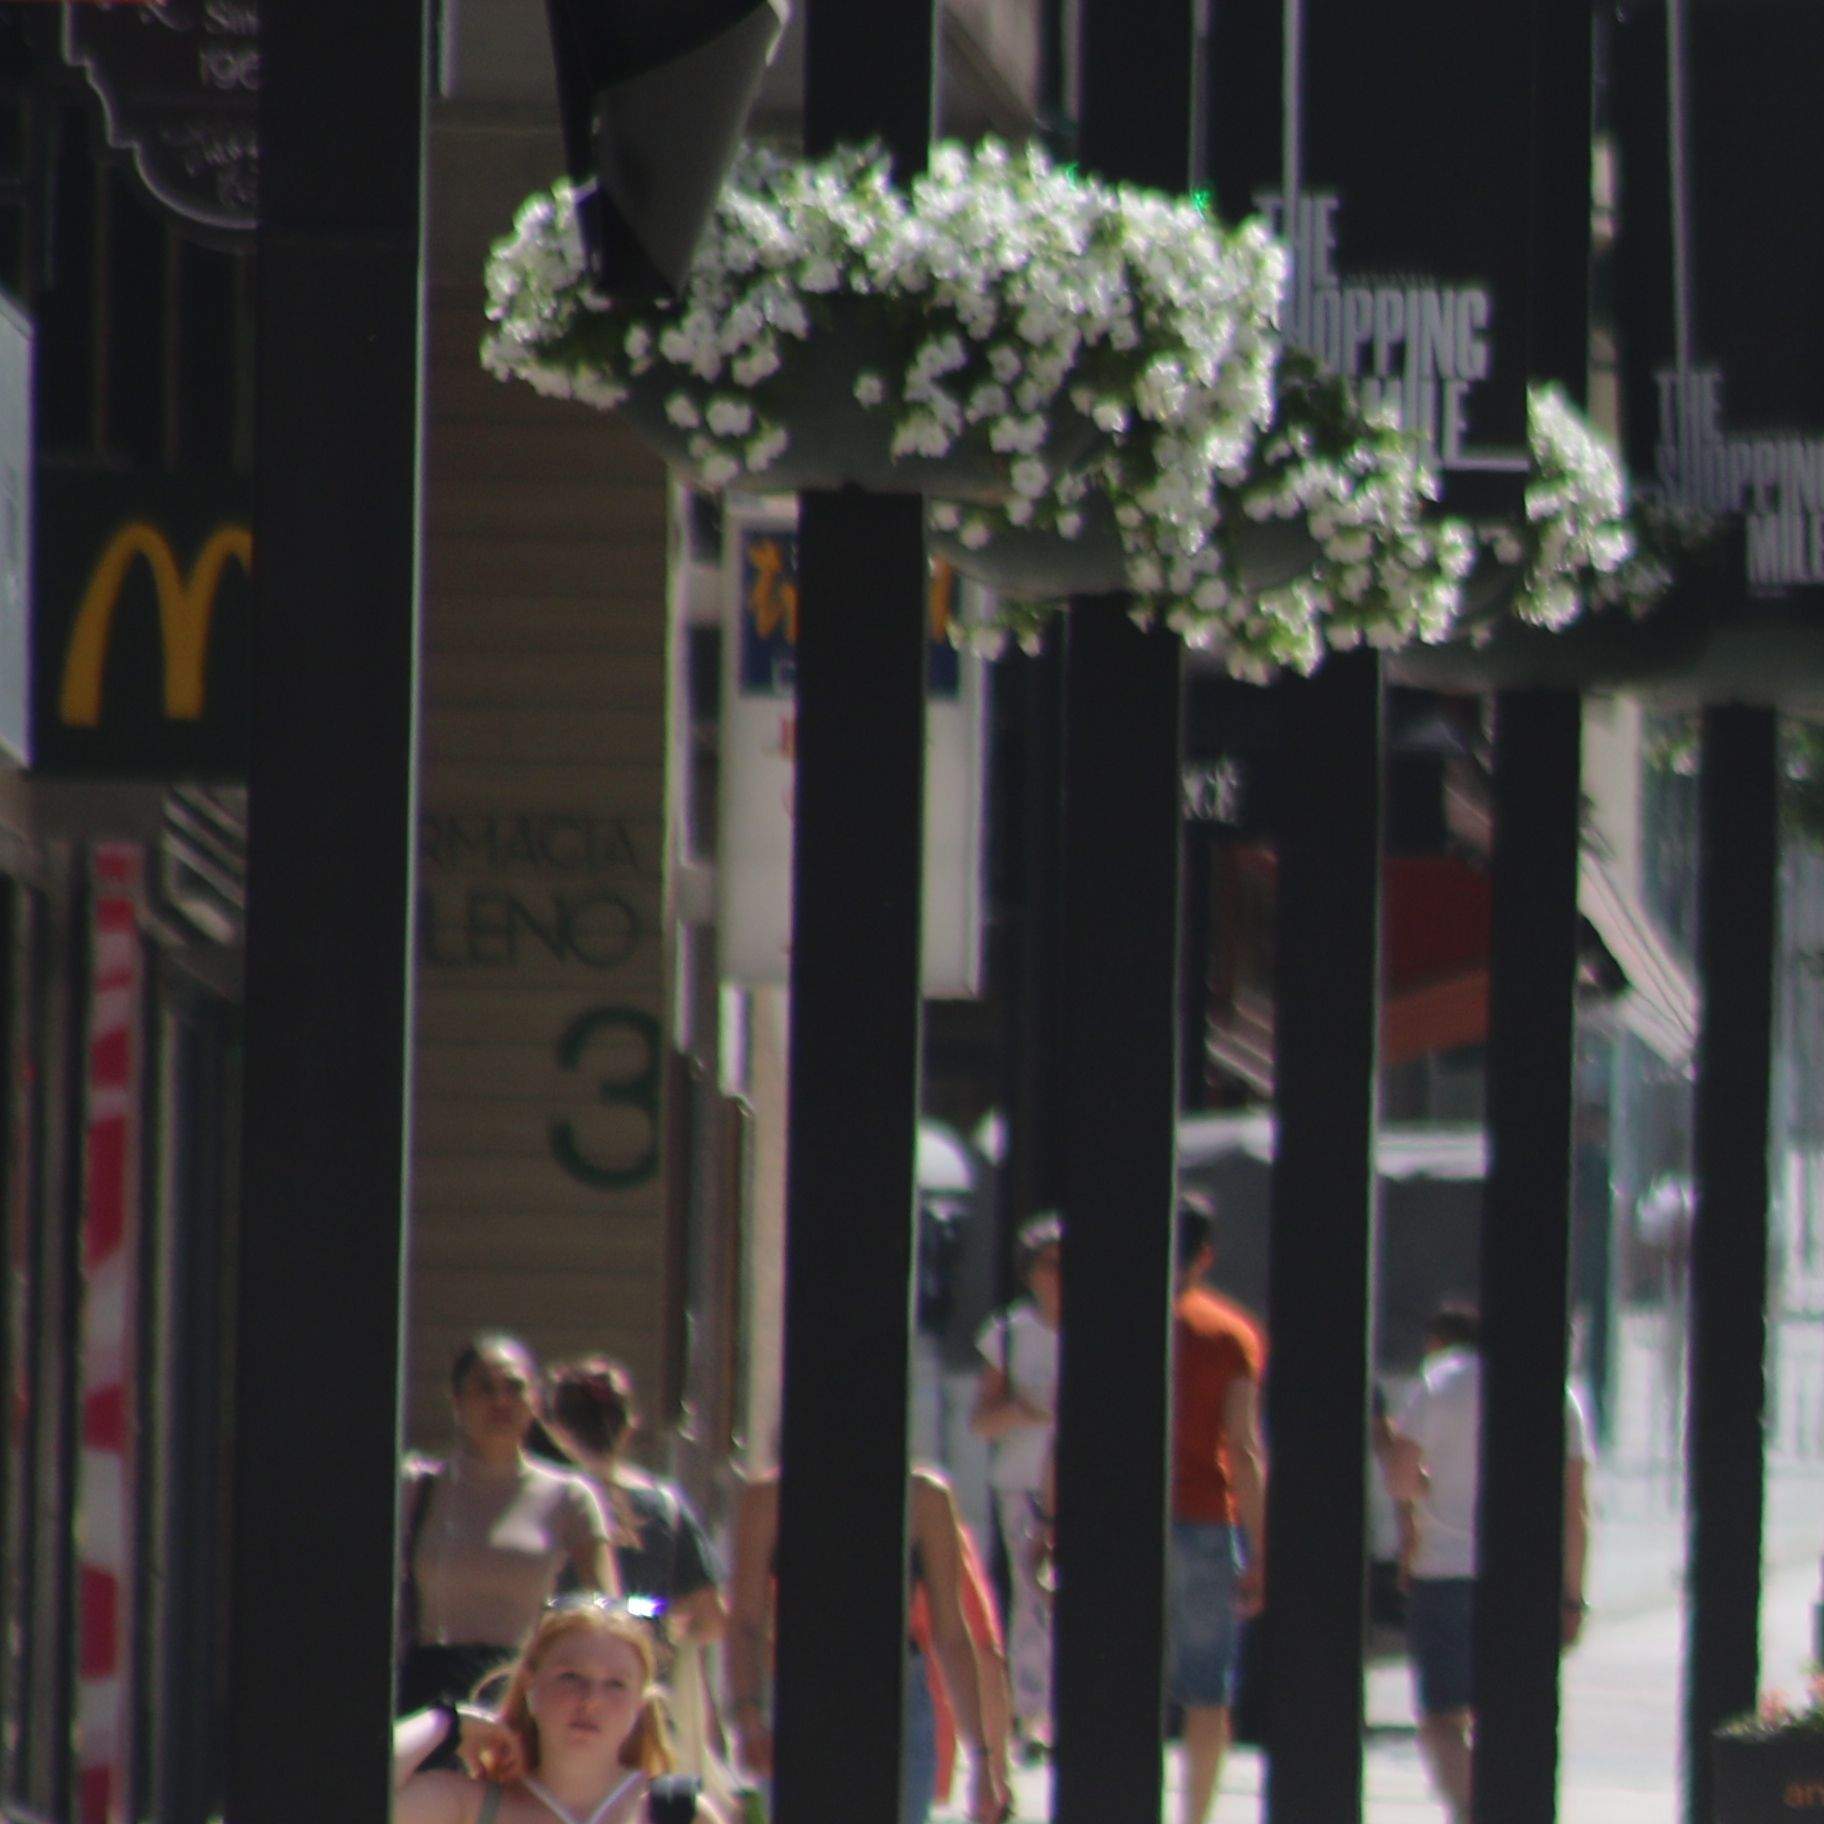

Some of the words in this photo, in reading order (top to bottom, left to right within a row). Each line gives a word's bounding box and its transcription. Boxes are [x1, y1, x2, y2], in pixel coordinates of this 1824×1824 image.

[1281, 286, 1490, 380] HOPPING
[422, 812, 641, 870] RMACIA
[424, 887, 641, 969] LENO
[549, 1003, 661, 1190] 3
